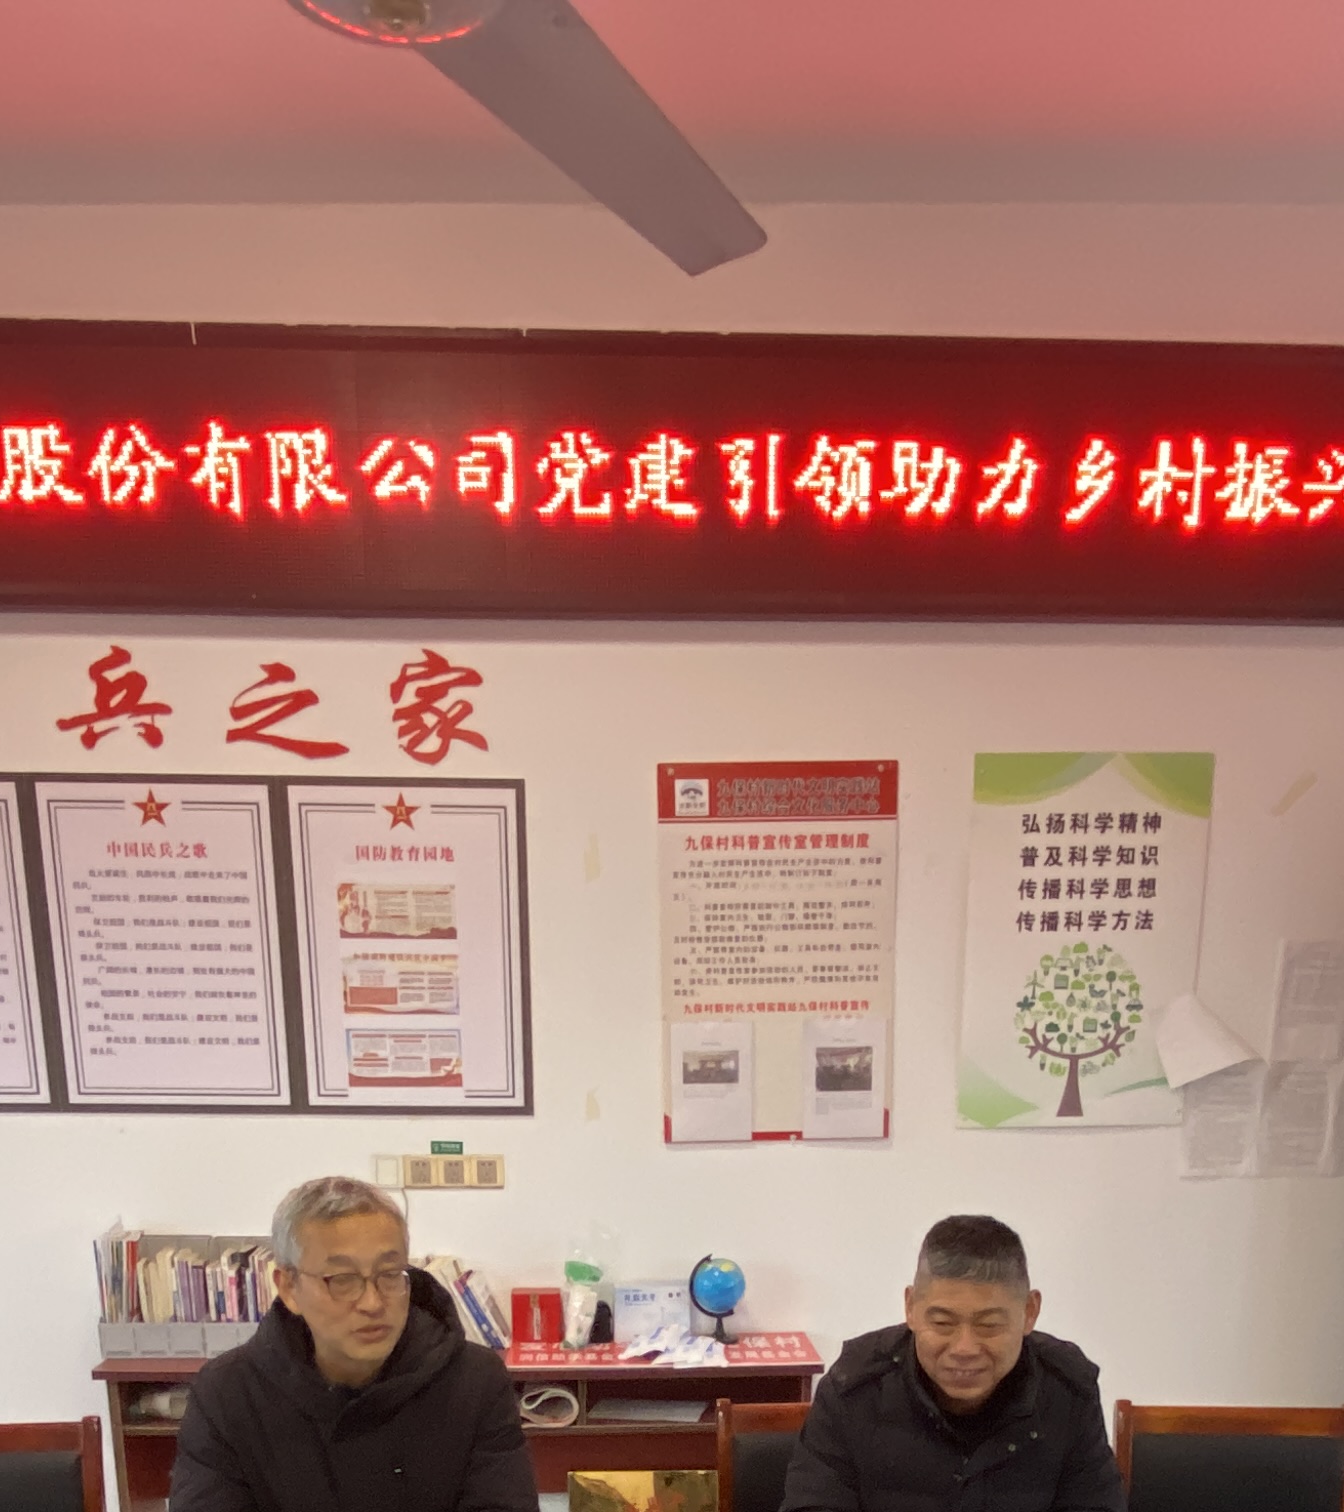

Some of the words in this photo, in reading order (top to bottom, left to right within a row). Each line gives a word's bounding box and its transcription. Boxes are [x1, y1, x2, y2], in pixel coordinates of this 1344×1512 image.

[1021, 812, 1162, 835] 弘扬科学精神
[107, 841, 208, 859] 中国民兵之歌
[685, 832, 870, 851] 九保村科普宣传室管理制度
[355, 845, 456, 863] 国防教育园地
[1019, 846, 1160, 868] 普及科学知识
[1018, 877, 1157, 901] 传播科学思想
[1016, 910, 1155, 933] 传播科学方法
